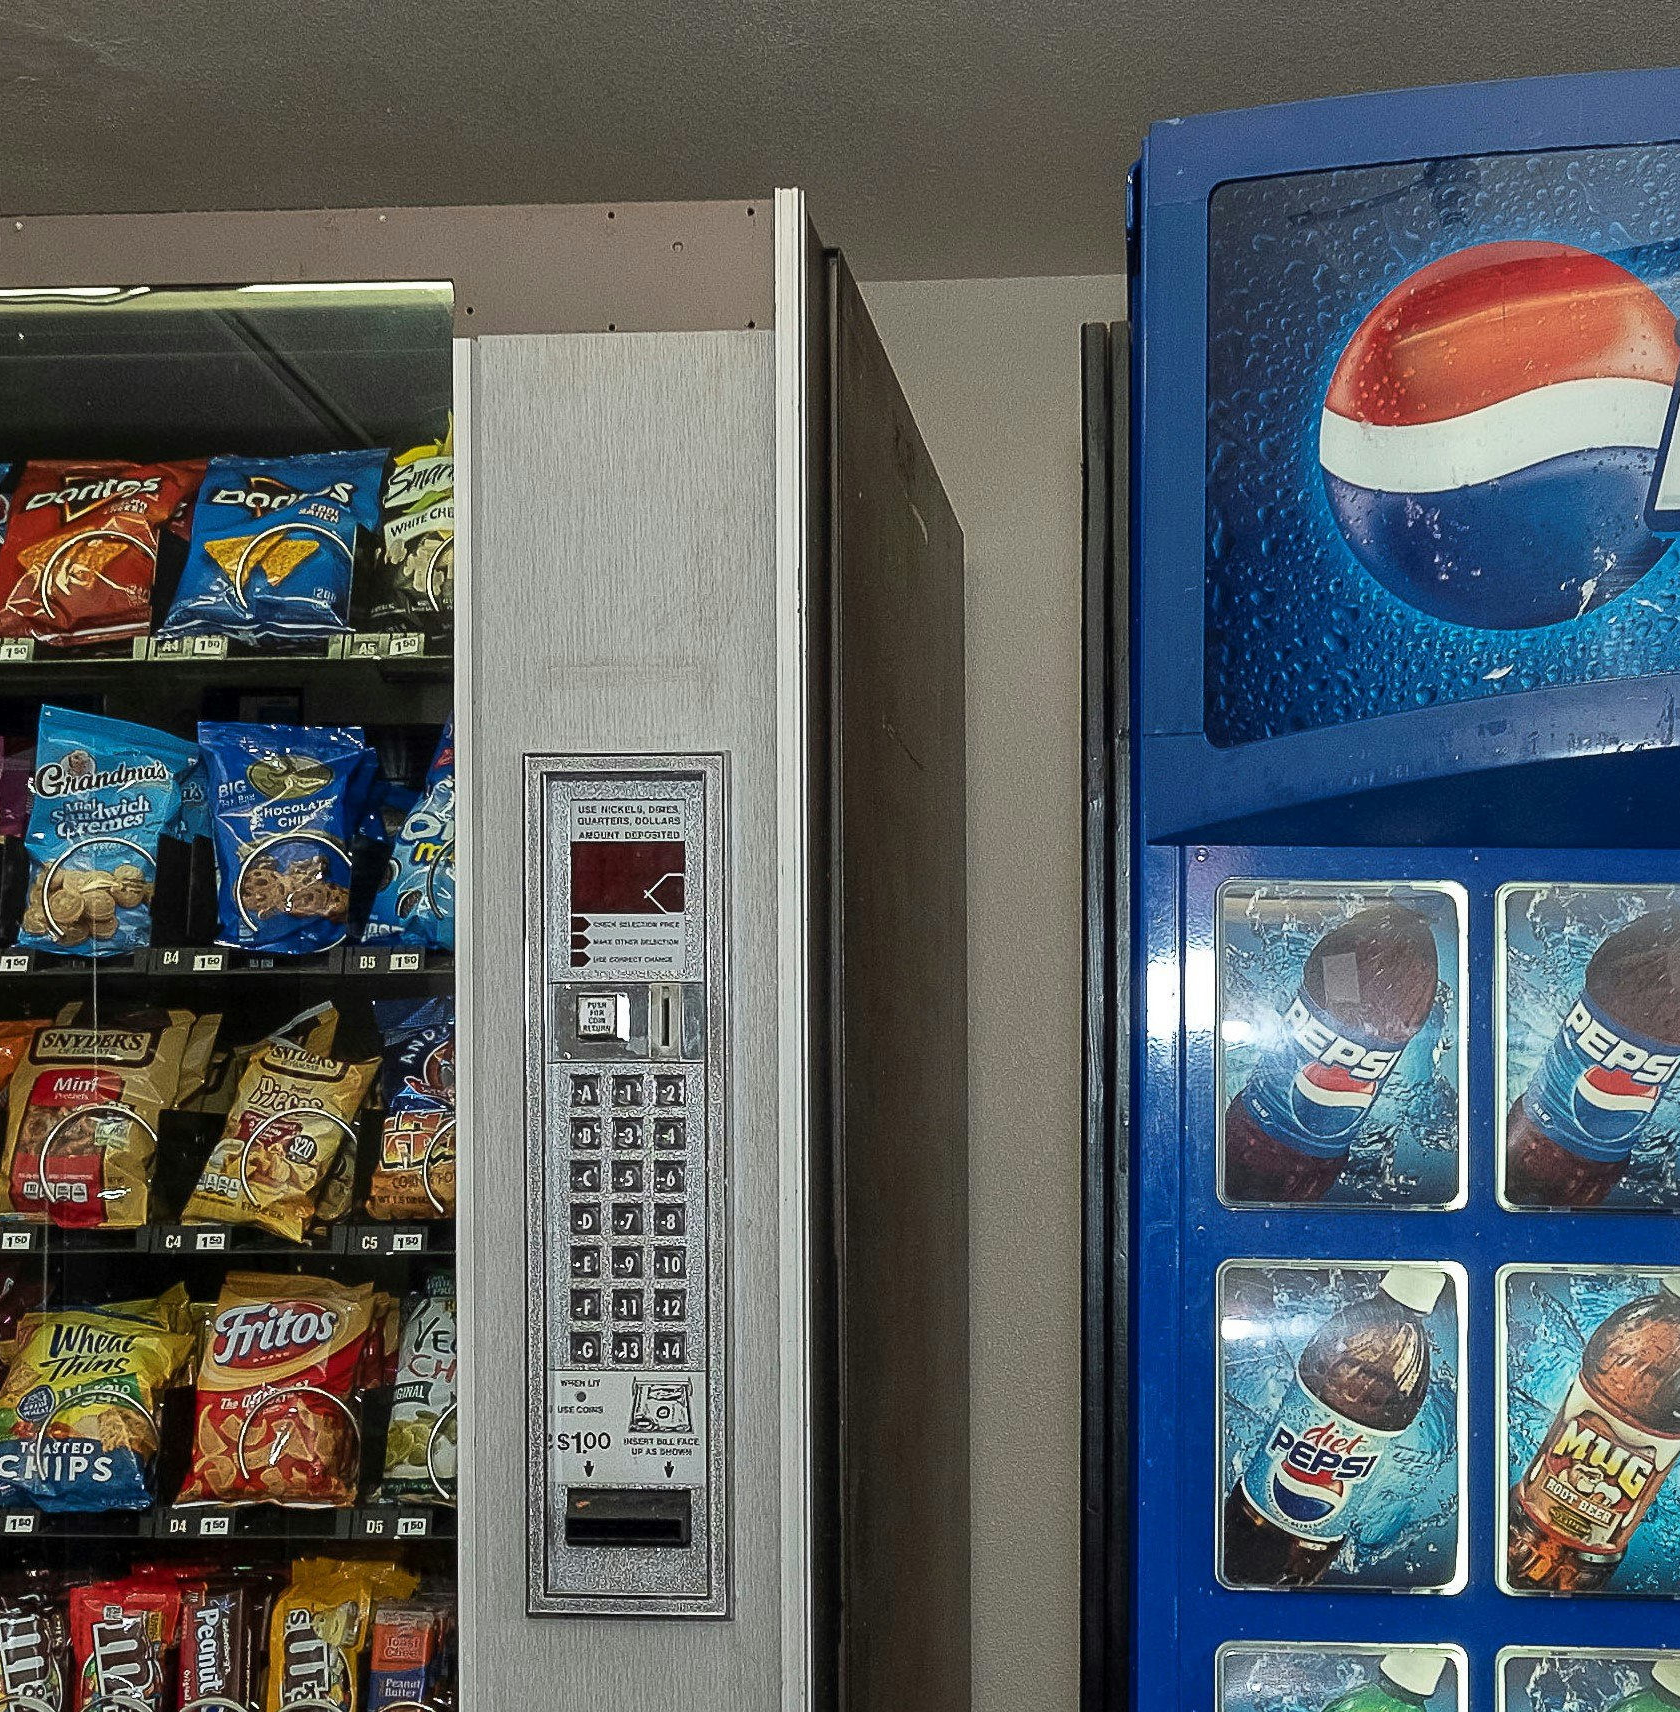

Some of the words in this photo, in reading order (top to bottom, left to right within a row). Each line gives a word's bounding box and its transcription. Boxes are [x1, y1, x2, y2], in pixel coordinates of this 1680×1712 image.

[25, 476, 162, 512] Doritos
[390, 513, 428, 537] WHITE
[35, 760, 169, 799] Grandma's
[219, 779, 247, 798] BIG
[578, 805, 597, 814] USE
[577, 817, 632, 827] QUARTERS,
[635, 817, 681, 826] DOLLARS
[578, 831, 619, 840] AMOUNT
[624, 831, 680, 840] DEPOSITED
[1282, 998, 1400, 1081] PEPSI
[581, 1085, 592, 1101] A
[666, 1085, 675, 1102] 2
[624, 1127, 634, 1144] 3
[582, 1170, 592, 1187] C
[624, 1170, 634, 1187] 5
[666, 1170, 676, 1187] 6
[582, 1213, 593, 1230] D
[624, 1213, 634, 1230] 7
[666, 1213, 676, 1230] 8
[583, 1256, 592, 1273] E
[624, 1256, 634, 1273] 9
[663, 1256, 681, 1274] 10
[584, 1299, 591, 1316] F
[621, 1299, 637, 1316] 11
[663, 1299, 681, 1316] 12
[49, 1323, 136, 1358] Wheat
[213, 1302, 339, 1366] Fritos
[414, 1316, 457, 1353] VE
[582, 1341, 593, 1359] G
[621, 1342, 639, 1359] 13
[663, 1342, 680, 1359] 14
[39, 1355, 131, 1383] Thins
[408, 1354, 457, 1384] CH
[557, 1406, 575, 1414] USE
[576, 1406, 604, 1414] COINS
[557, 1431, 612, 1455] $1.00
[623, 1438, 654, 1446] INSERT
[677, 1438, 700, 1446] FACE
[1303, 1421, 1369, 1456] diet
[631, 1448, 644, 1456] UP
[645, 1448, 658, 1456] AS
[660, 1448, 693, 1456] SHOWN
[1270, 1427, 1379, 1479] PEPSI
[1552, 1420, 1654, 1500] MUG
[1546, 1478, 1576, 1505] ROOT
[1578, 1500, 1612, 1524] BEER
[195, 1608, 224, 1694] Peanut
[385, 1678, 421, 1689] Peanut
[385, 1688, 417, 1698] Butter
